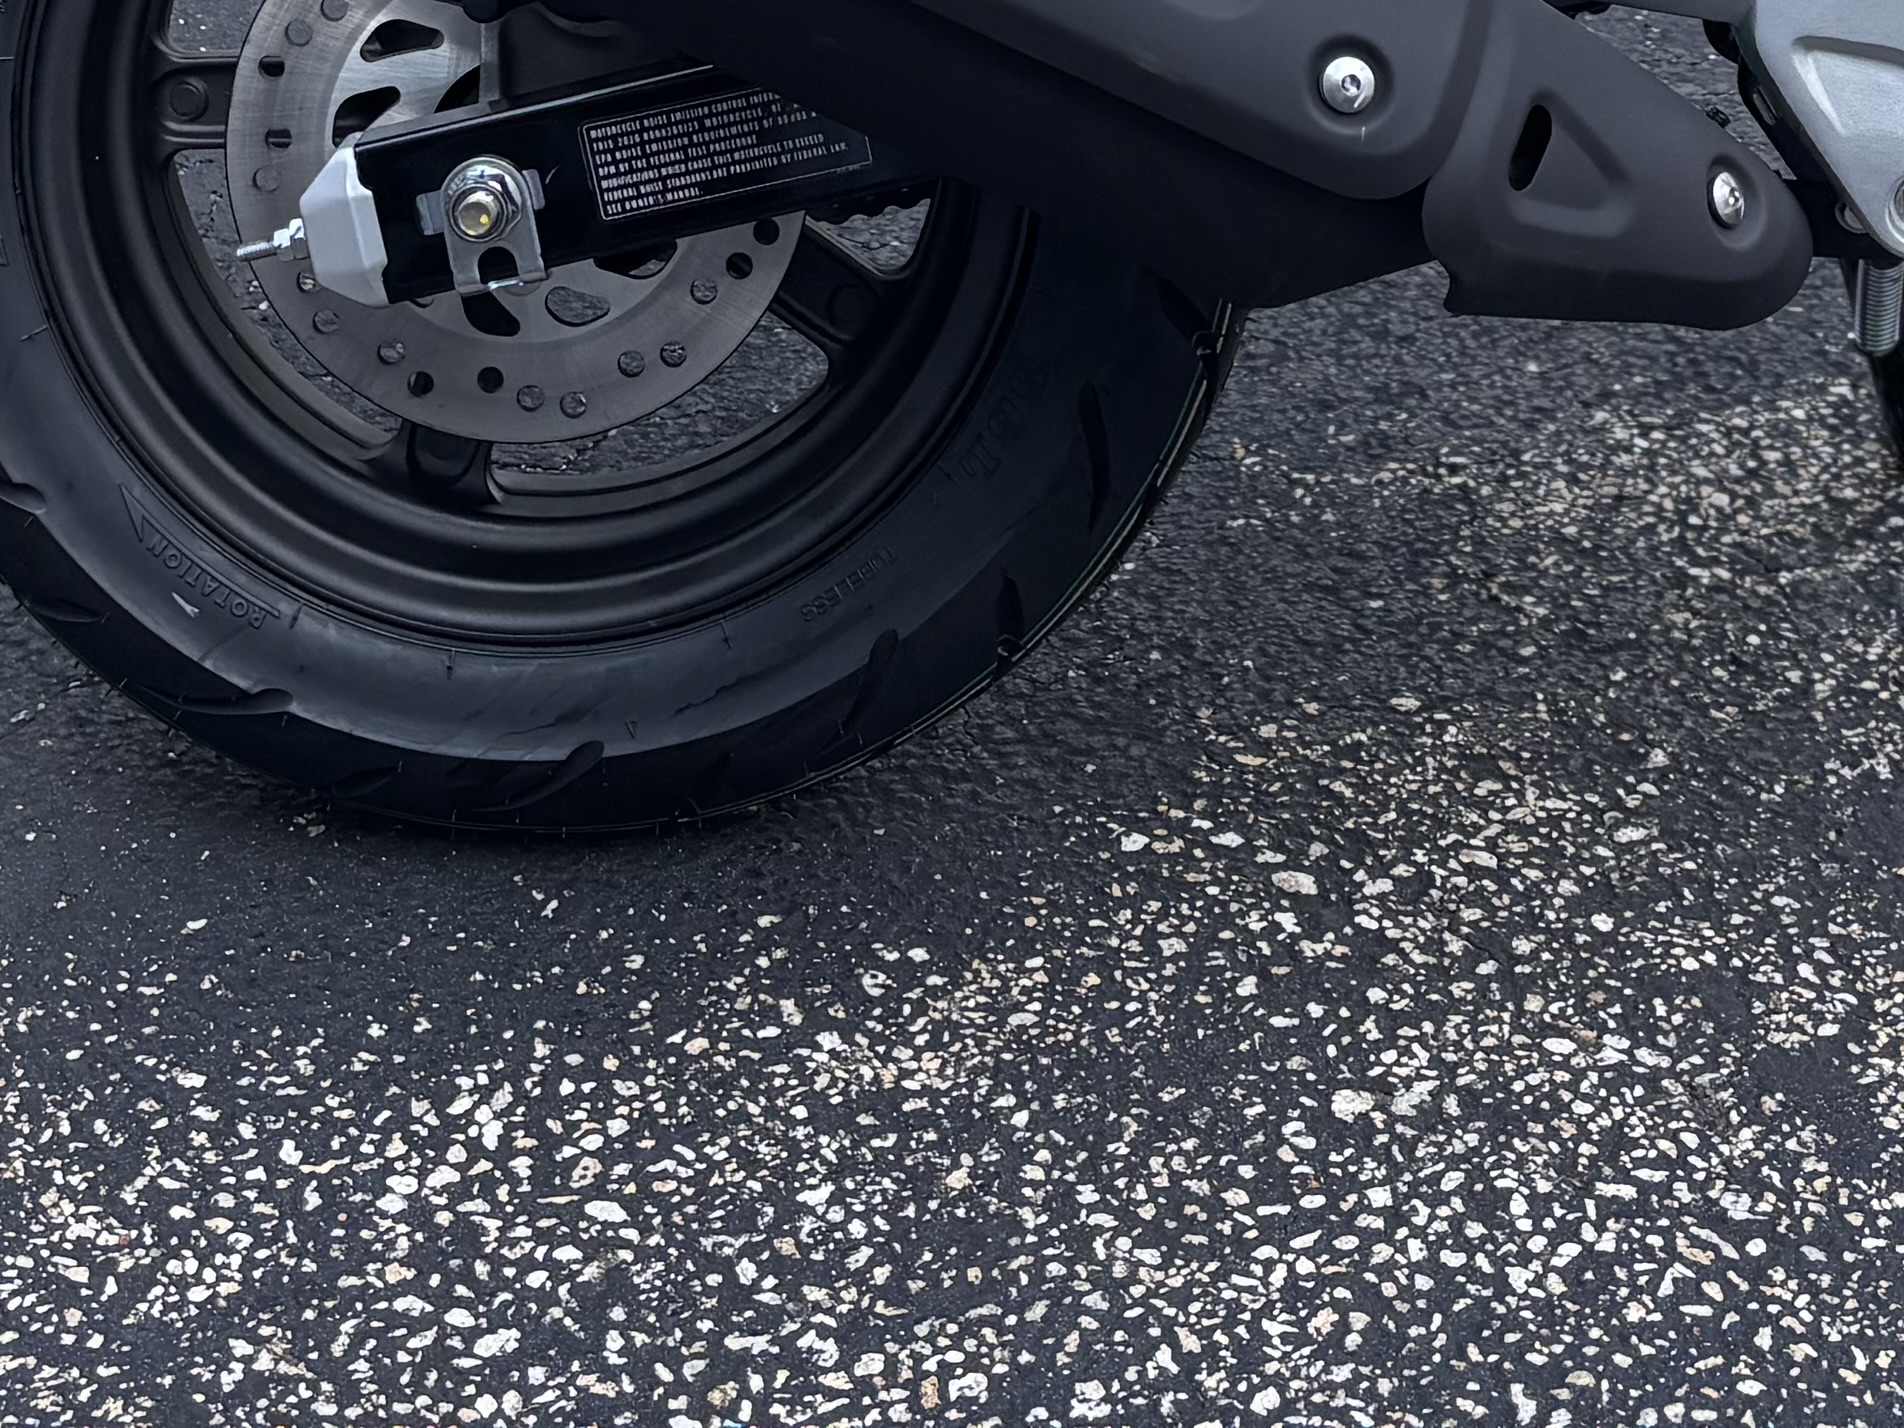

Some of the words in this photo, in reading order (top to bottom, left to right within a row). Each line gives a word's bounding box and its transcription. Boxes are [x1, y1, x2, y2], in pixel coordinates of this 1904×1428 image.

[595, 152, 612, 165] EPA
[614, 146, 643, 161] NOISE
[603, 186, 638, 202] FEDERAL
[792, 145, 828, 161] FEDERAL
[649, 149, 685, 166] FEDERAL
[606, 202, 623, 215] SEE
[146, 535, 267, 630] ROTATION
[800, 544, 898, 623] TUBELESS
